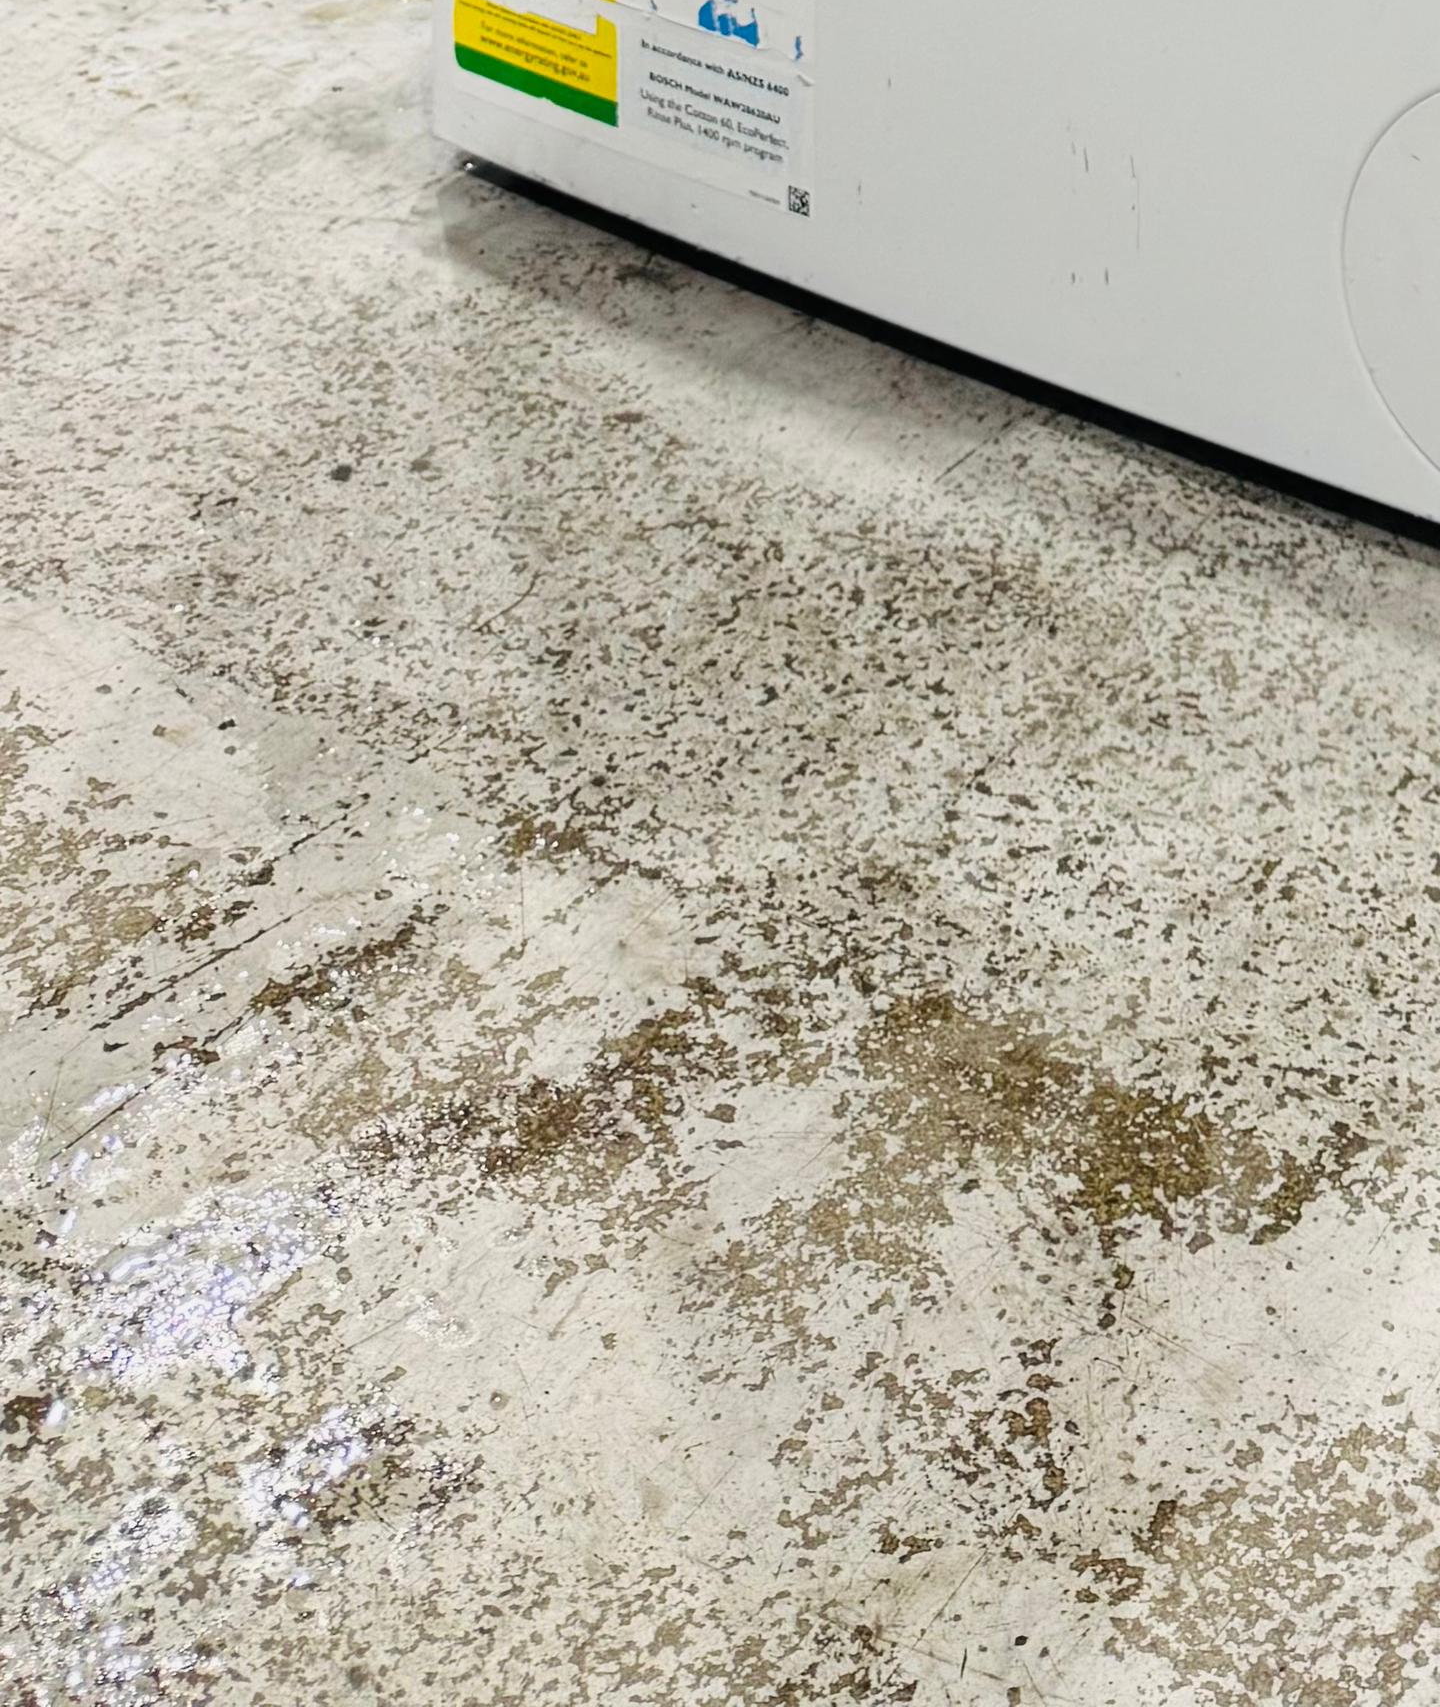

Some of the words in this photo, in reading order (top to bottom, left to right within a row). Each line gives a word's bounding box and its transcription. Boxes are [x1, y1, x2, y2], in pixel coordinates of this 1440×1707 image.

[649, 71, 683, 91] BOSCH
[685, 84, 711, 101] Model
[640, 87, 665, 109] Using
[667, 97, 683, 113] the
[647, 106, 672, 125] Rinse
